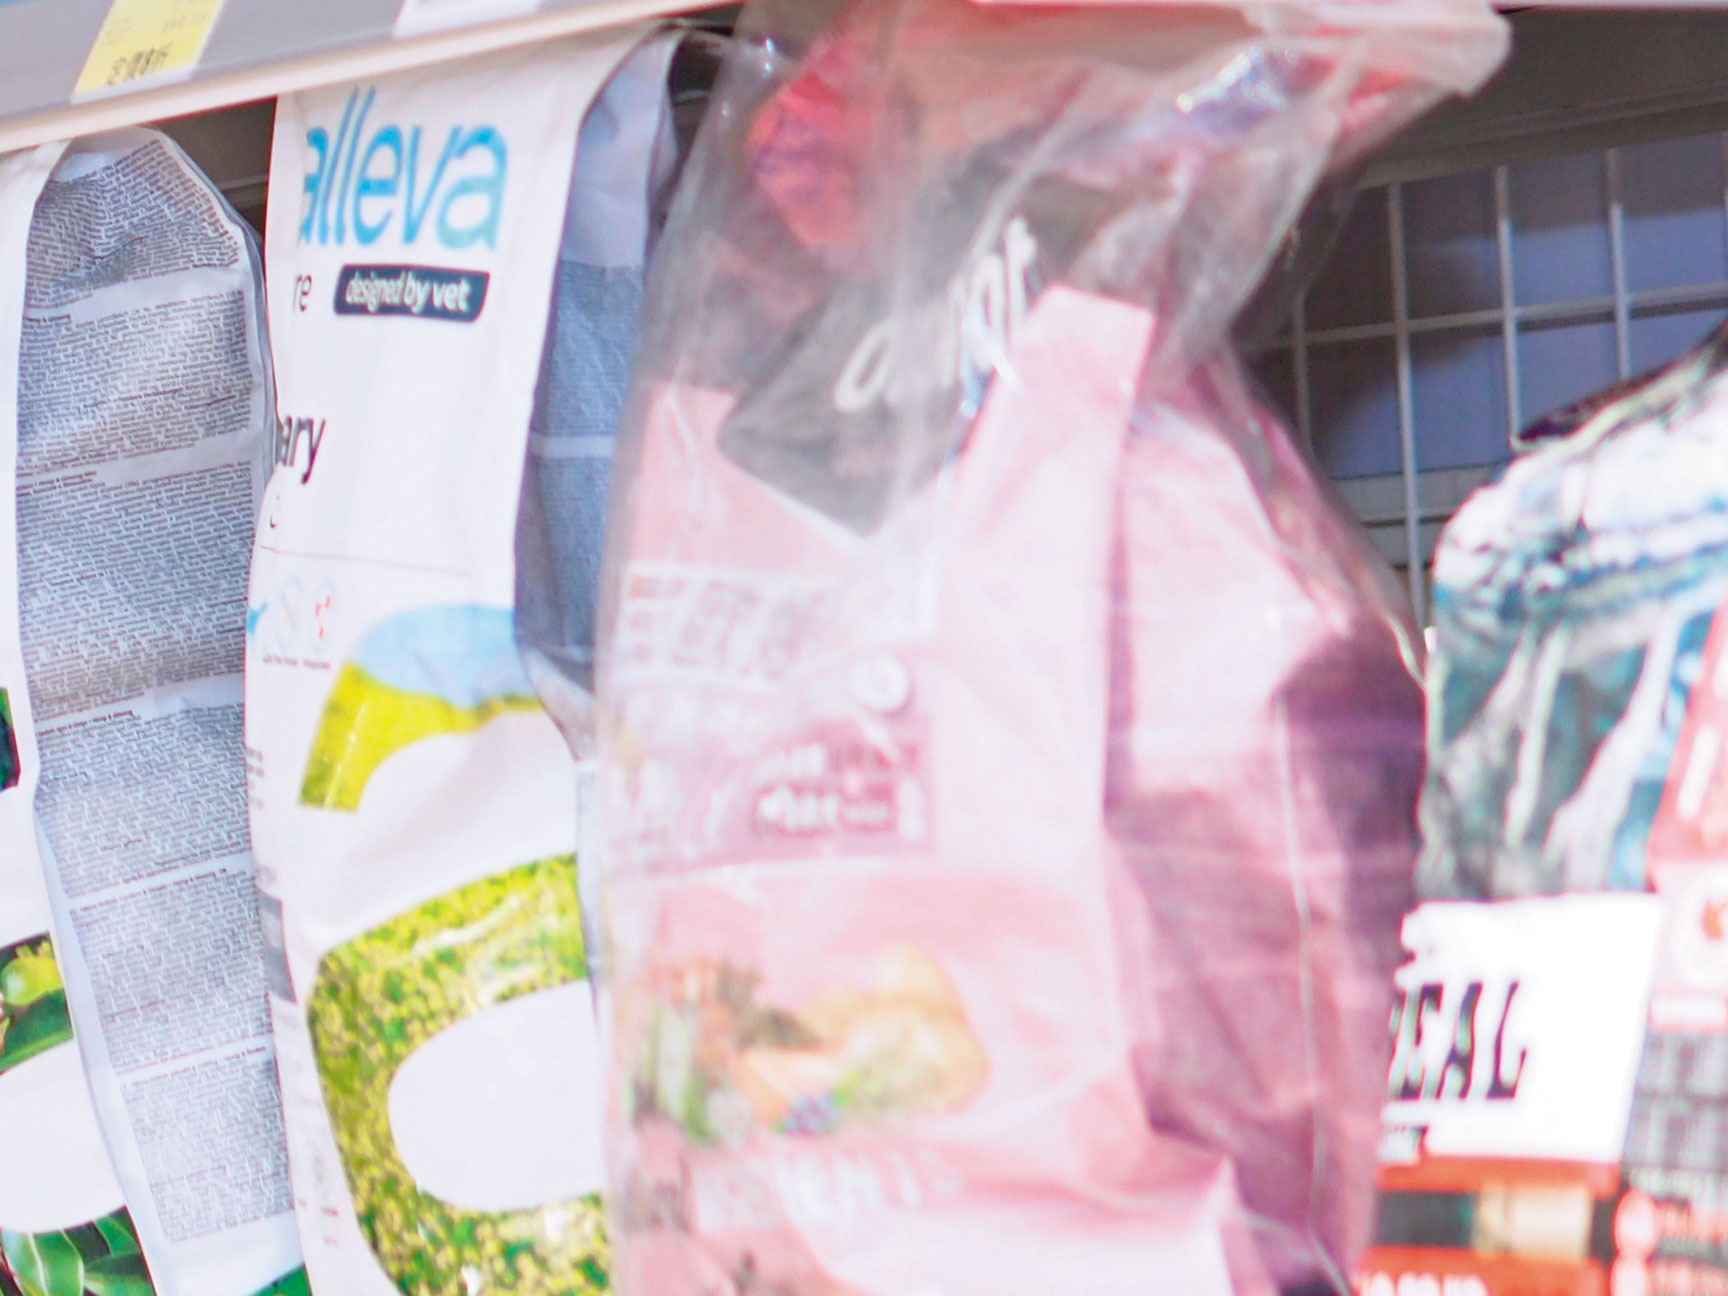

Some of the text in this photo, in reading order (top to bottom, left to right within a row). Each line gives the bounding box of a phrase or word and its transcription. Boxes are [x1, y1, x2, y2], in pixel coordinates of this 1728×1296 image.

[297, 85, 508, 253] alleva
[345, 270, 471, 316] designed by vet
